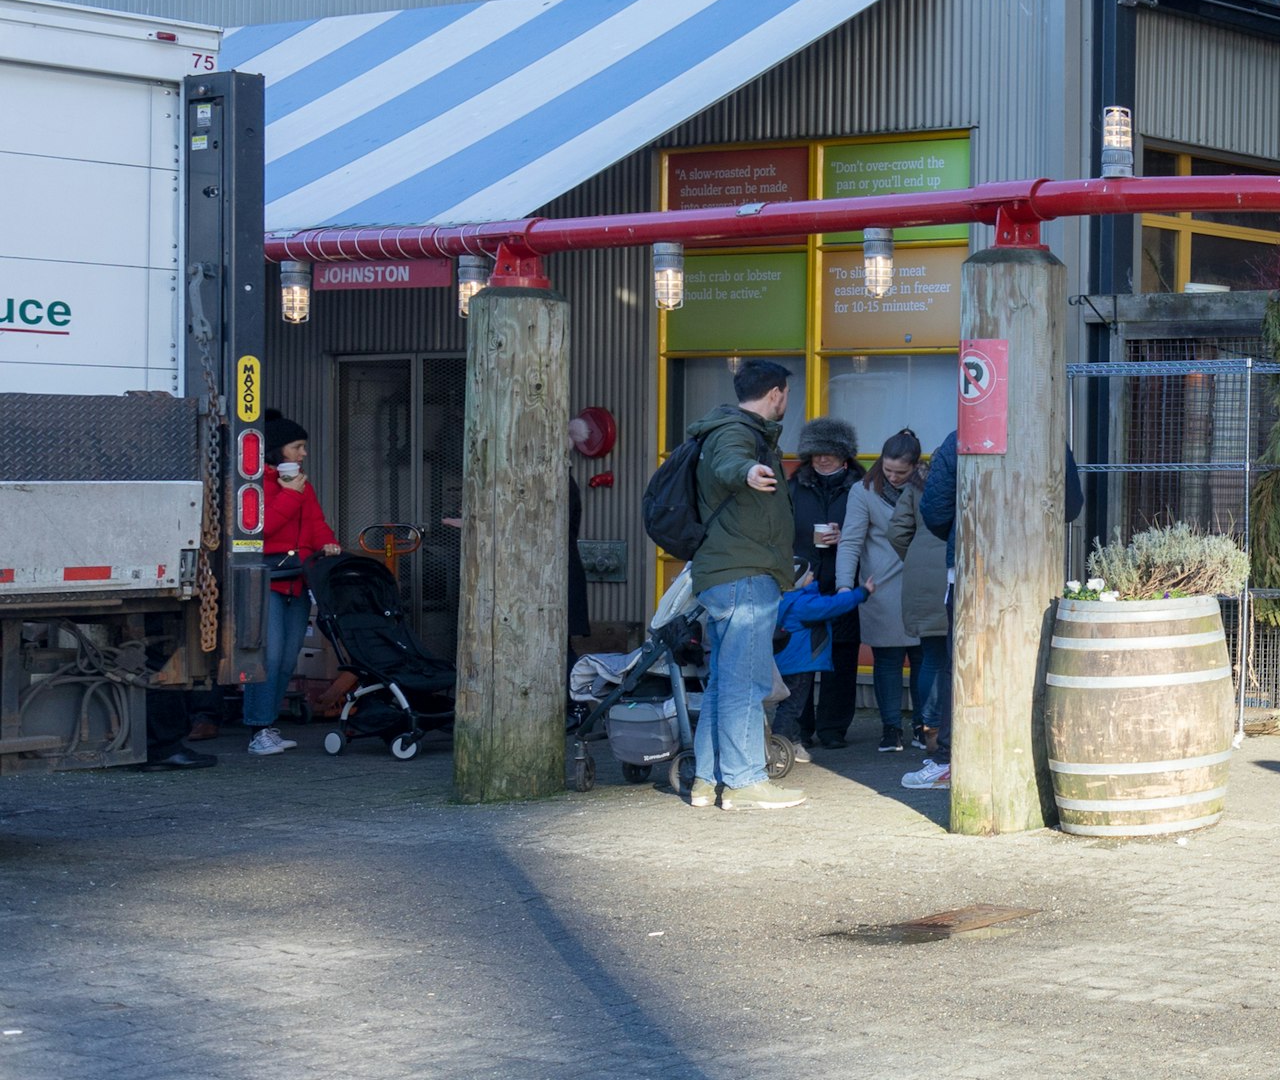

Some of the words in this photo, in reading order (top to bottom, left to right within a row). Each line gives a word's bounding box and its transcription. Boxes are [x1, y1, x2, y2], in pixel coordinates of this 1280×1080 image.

[192, 53, 214, 71] 75
[865, 158, 924, 171] over-crowd
[927, 156, 945, 168] the
[689, 166, 752, 181] slow-roasted
[753, 164, 777, 180] pork
[680, 184, 722, 197] shoulder
[724, 185, 742, 195] can
[745, 182, 757, 194] be
[760, 181, 788, 193] made
[836, 179, 855, 193] pan
[858, 179, 869, 189] or
[903, 174, 925, 188] end
[927, 176, 941, 190] up
[320, 266, 409, 283] JOHNSTON
[709, 270, 731, 282] crab
[734, 272, 744, 281] or
[747, 269, 782, 281] lobster
[899, 266, 926, 277] meat
[684, 288, 712, 300] hould
[715, 288, 727, 299] be
[901, 282, 911, 294] in
[914, 281, 951, 293] freezer
[834, 300, 848, 313] for
[852, 301, 879, 313] 10-15
[243, 364, 254, 414] MAXON
